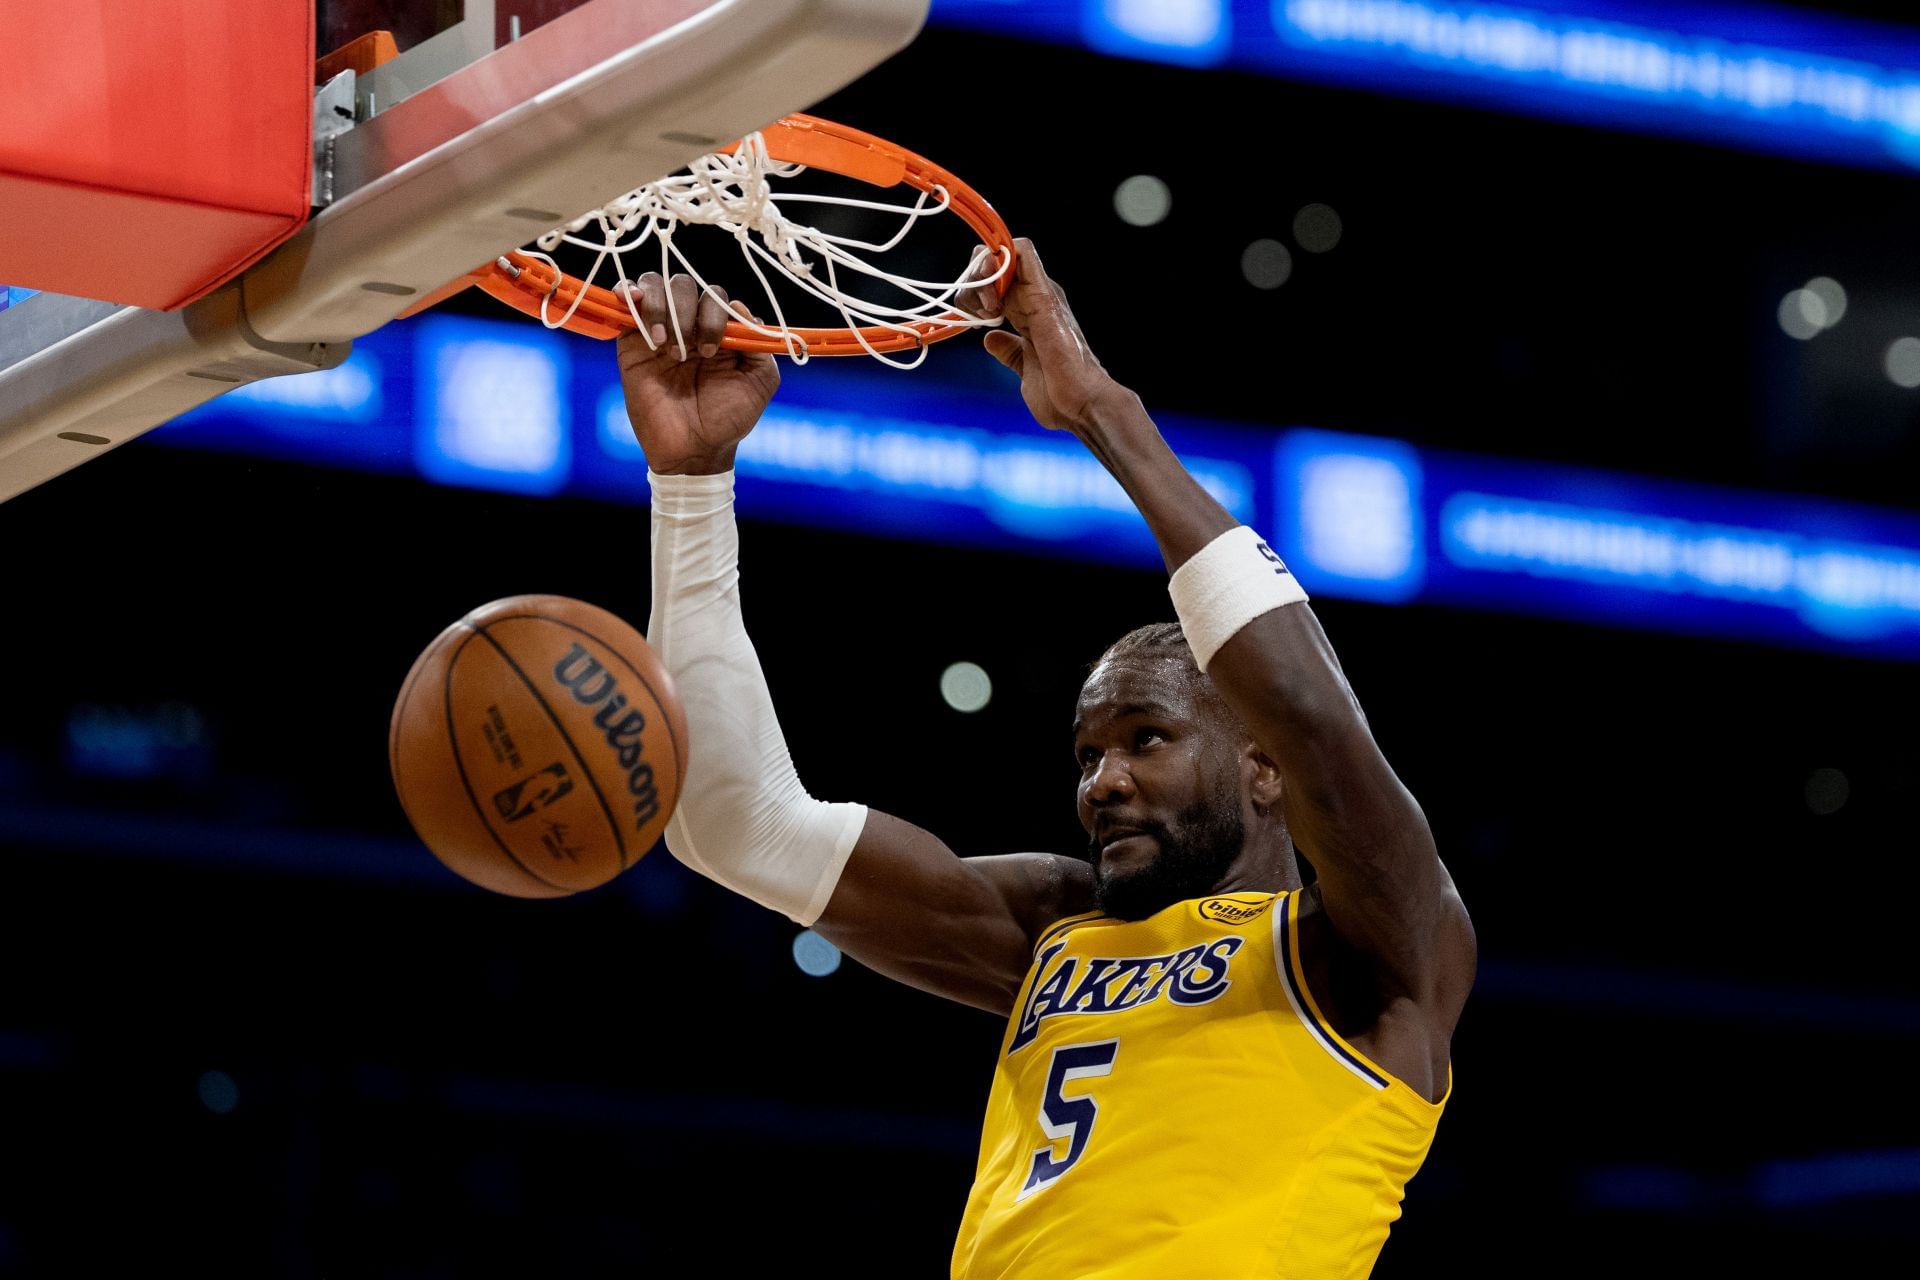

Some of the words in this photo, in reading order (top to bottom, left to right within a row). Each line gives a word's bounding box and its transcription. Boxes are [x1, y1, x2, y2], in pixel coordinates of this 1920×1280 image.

[554, 641, 660, 832] Wilson
[1007, 936, 1246, 1056] LAKERS
[1014, 1037, 1120, 1203] 5
